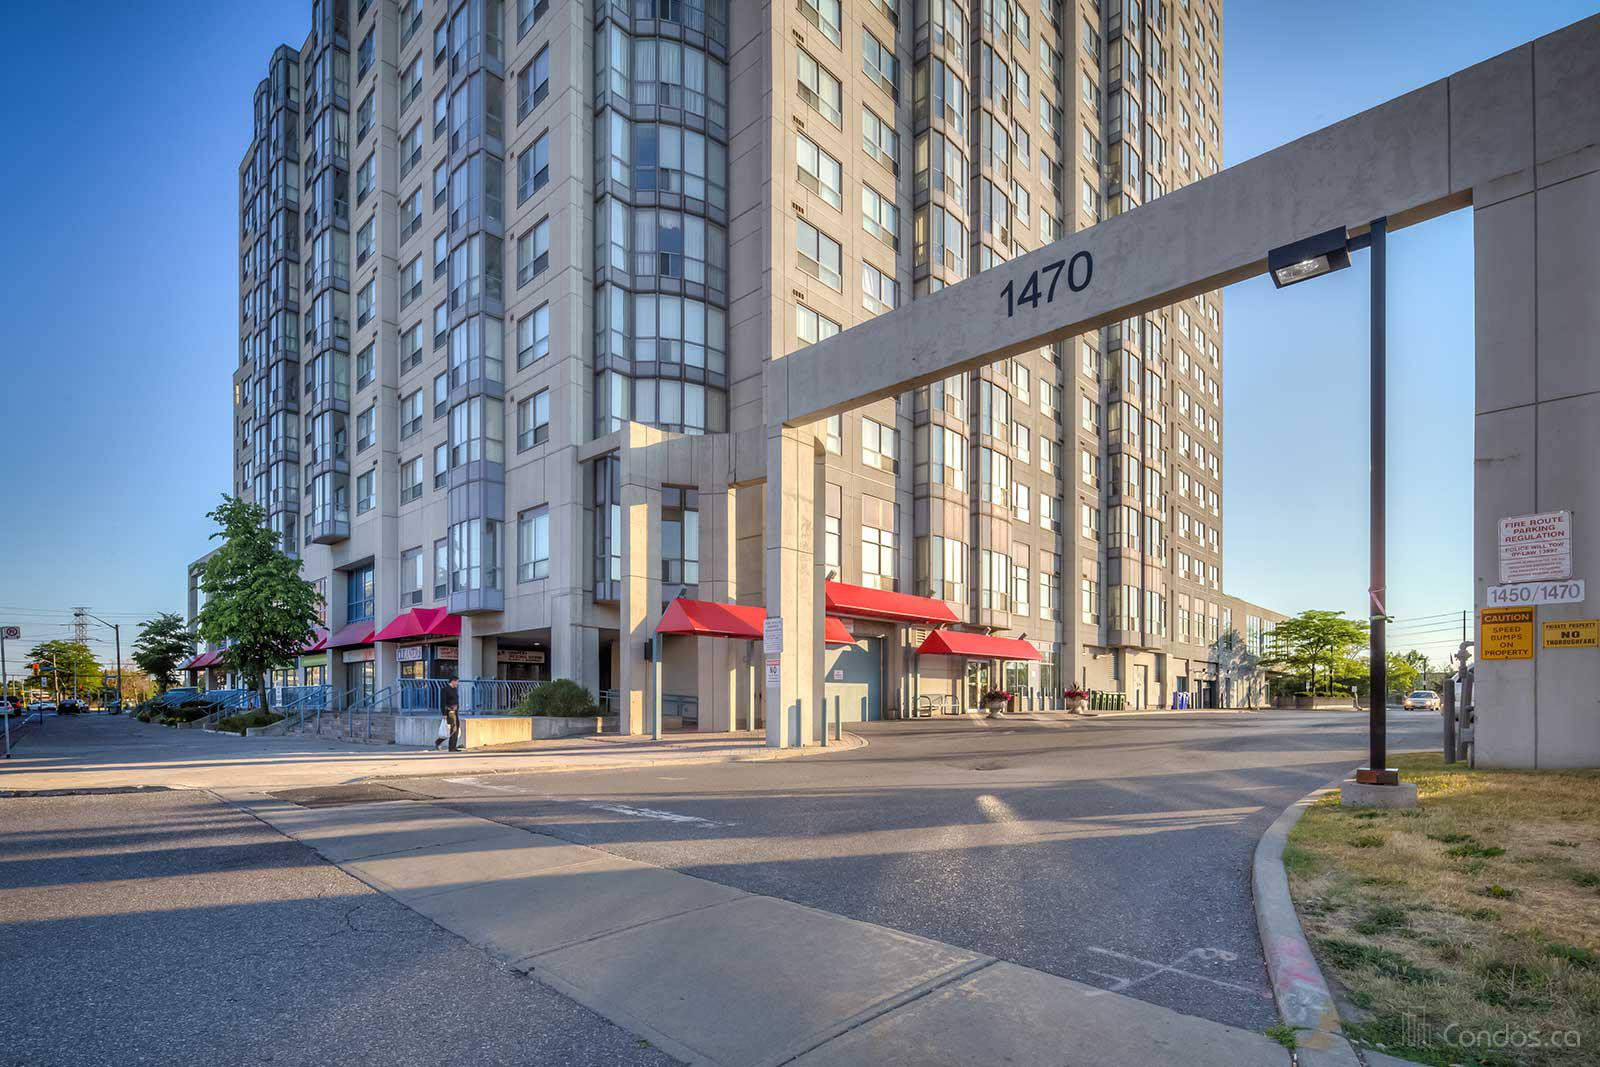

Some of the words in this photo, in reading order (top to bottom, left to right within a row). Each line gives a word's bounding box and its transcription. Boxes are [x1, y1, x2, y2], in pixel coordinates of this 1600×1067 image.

[1000, 250, 1093, 318] 1470
[1505, 520, 1527, 529] FIRE
[1530, 516, 1564, 526] ROUTE
[1513, 524, 1556, 535] PARKING
[1505, 530, 1565, 543] REGULATION
[1491, 583, 1580, 603] 1450/1470
[1484, 613, 1529, 623] CAUTION
[1491, 633, 1523, 641] BUMPS
[1560, 630, 1580, 639] NO
[1546, 638, 1596, 646] THOROUGHFARE
